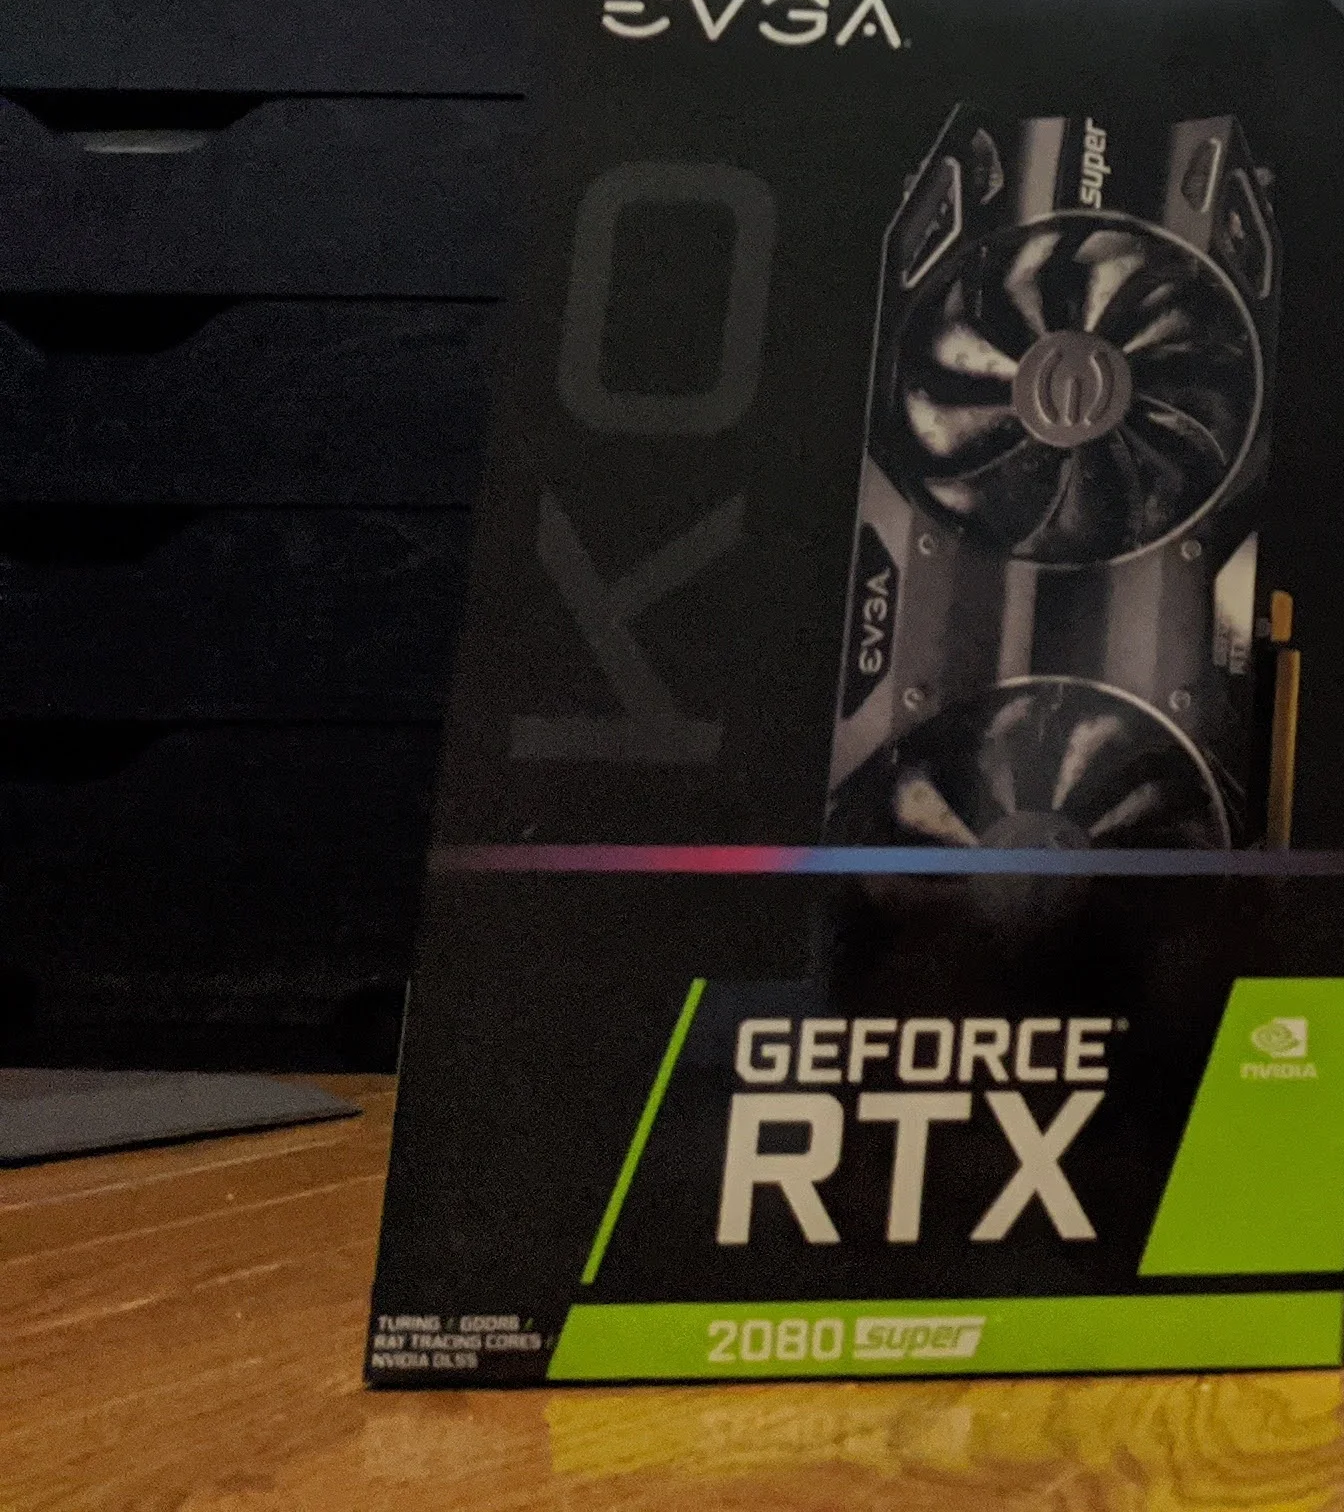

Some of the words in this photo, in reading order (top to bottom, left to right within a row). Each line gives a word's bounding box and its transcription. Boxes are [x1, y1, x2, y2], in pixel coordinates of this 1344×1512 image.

[1079, 117, 1108, 209] super
[858, 566, 893, 677] EVGA
[734, 1016, 1112, 1084] GEFORCE
[714, 1090, 1106, 1248] RTX
[707, 1318, 845, 1362] 2080
[854, 1320, 980, 1358] super
